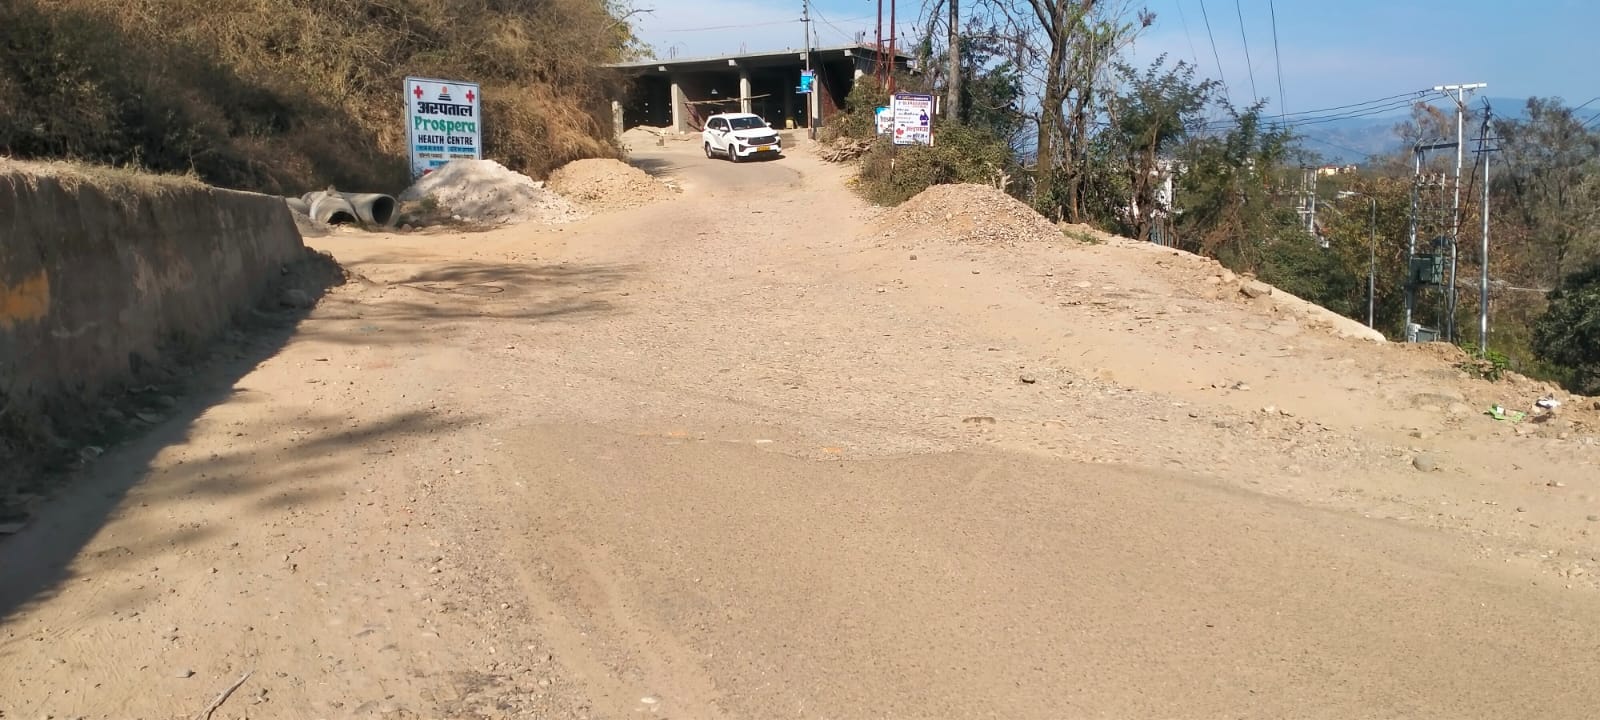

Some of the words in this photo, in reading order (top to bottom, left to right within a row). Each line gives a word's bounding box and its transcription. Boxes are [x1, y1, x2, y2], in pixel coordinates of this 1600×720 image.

[417, 101, 473, 117] अस्पताल
[414, 116, 476, 135] Prospera
[418, 134, 445, 144] HEALTH
[447, 135, 473, 145] CENTRE
